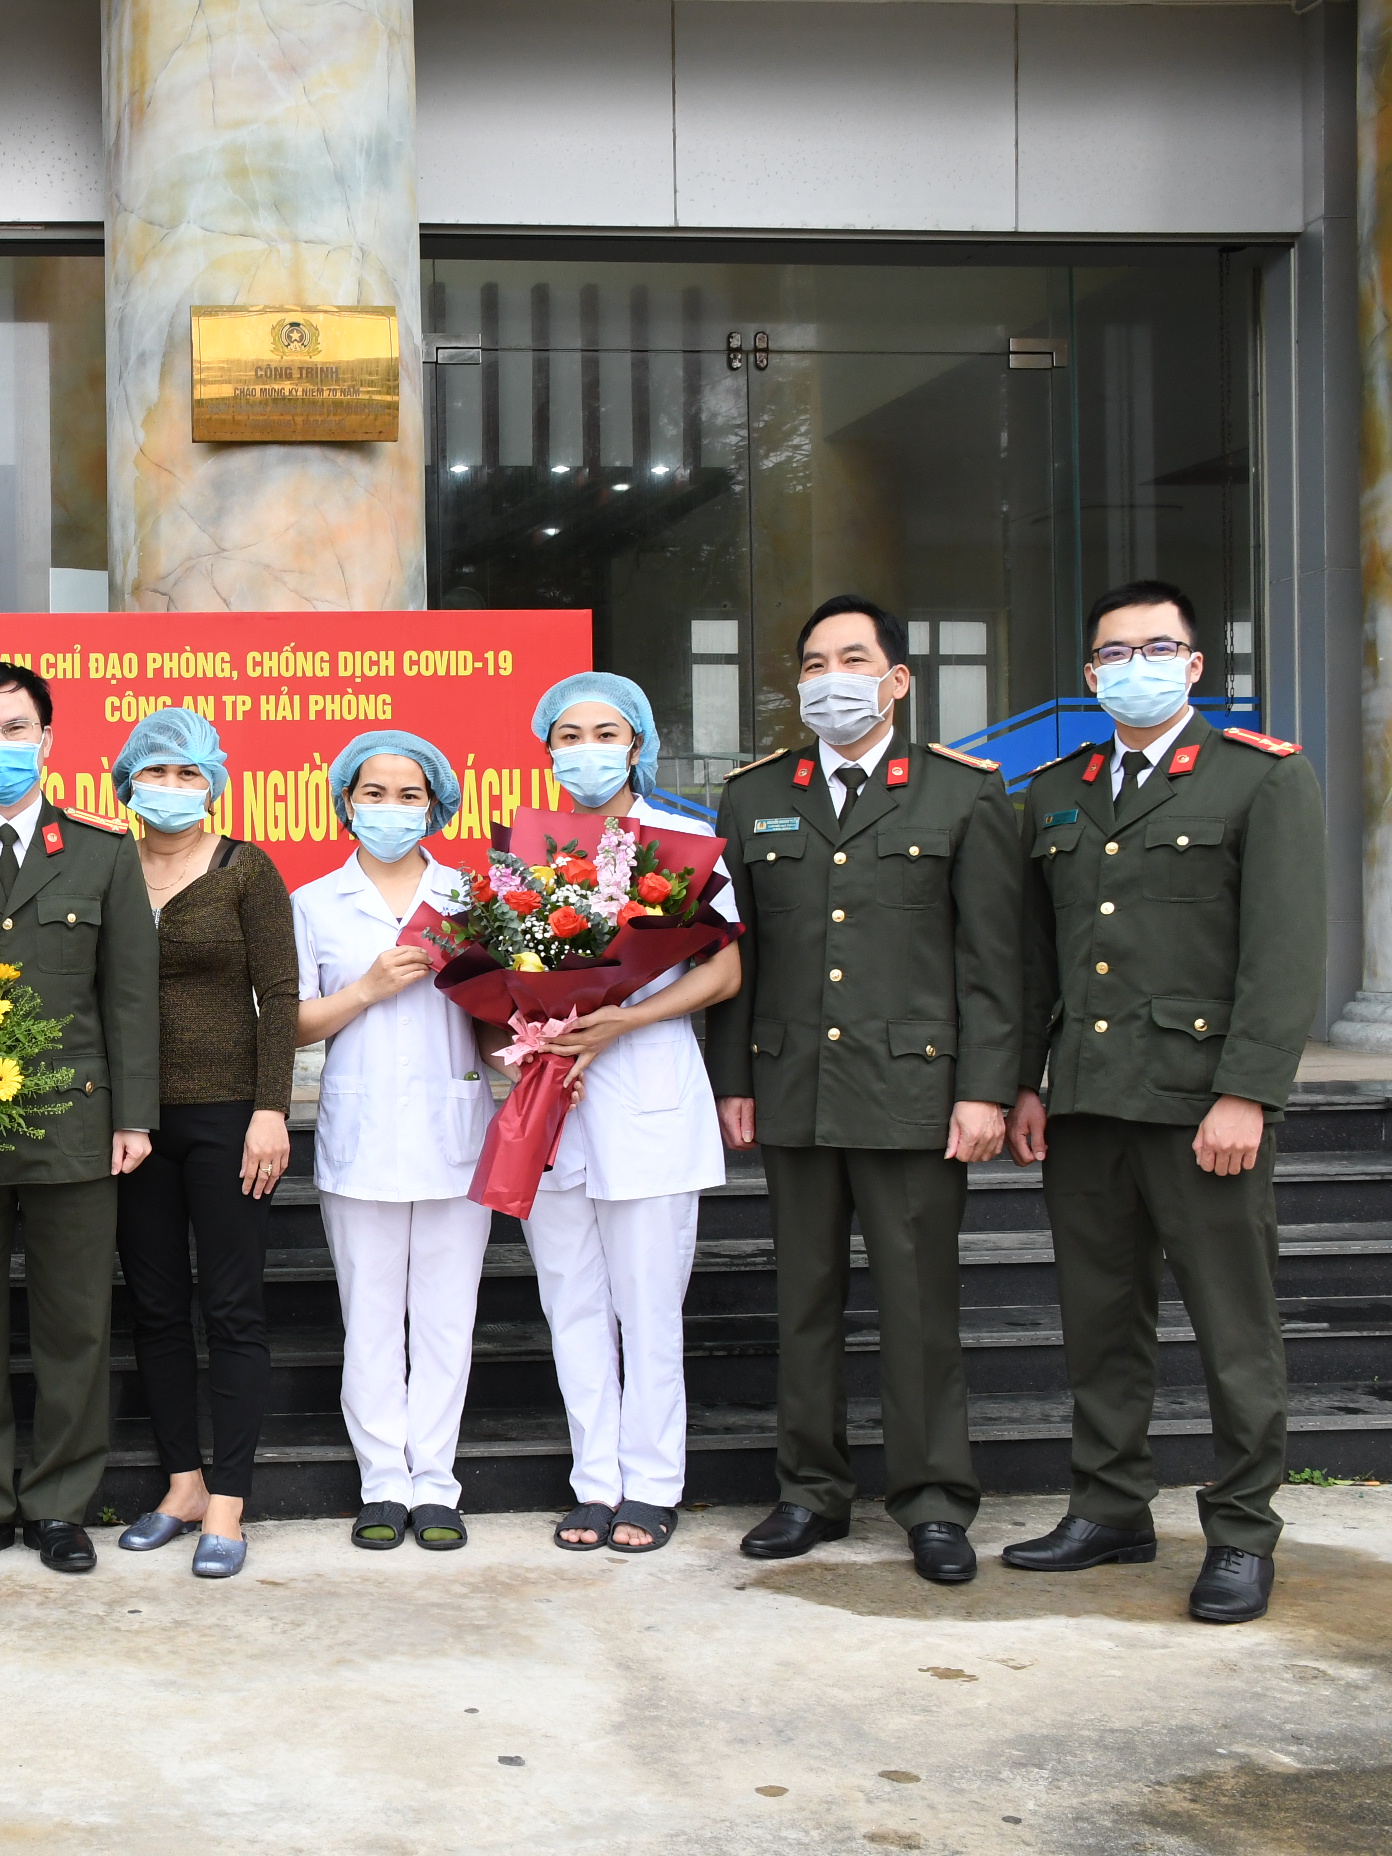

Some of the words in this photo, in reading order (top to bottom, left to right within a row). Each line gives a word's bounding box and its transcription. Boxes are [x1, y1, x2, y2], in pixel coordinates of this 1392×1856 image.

[255, 364, 293, 380] CÔNG
[298, 364, 339, 380] TRÌNH
[326, 387, 338, 398] 70
[40, 644, 82, 679] CHỈ
[88, 652, 138, 684] ĐẠO
[146, 645, 238, 681] PHÒNG,
[246, 642, 330, 678] CHỐNG
[338, 650, 395, 682] DỊCH
[403, 650, 513, 677] COVID-19
[222, 695, 252, 721] TP
[260, 686, 300, 721] HẢI
[308, 688, 392, 720] PHÒNG
[243, 752, 338, 842] NGƯỜI
[441, 753, 521, 840] ÁCH
